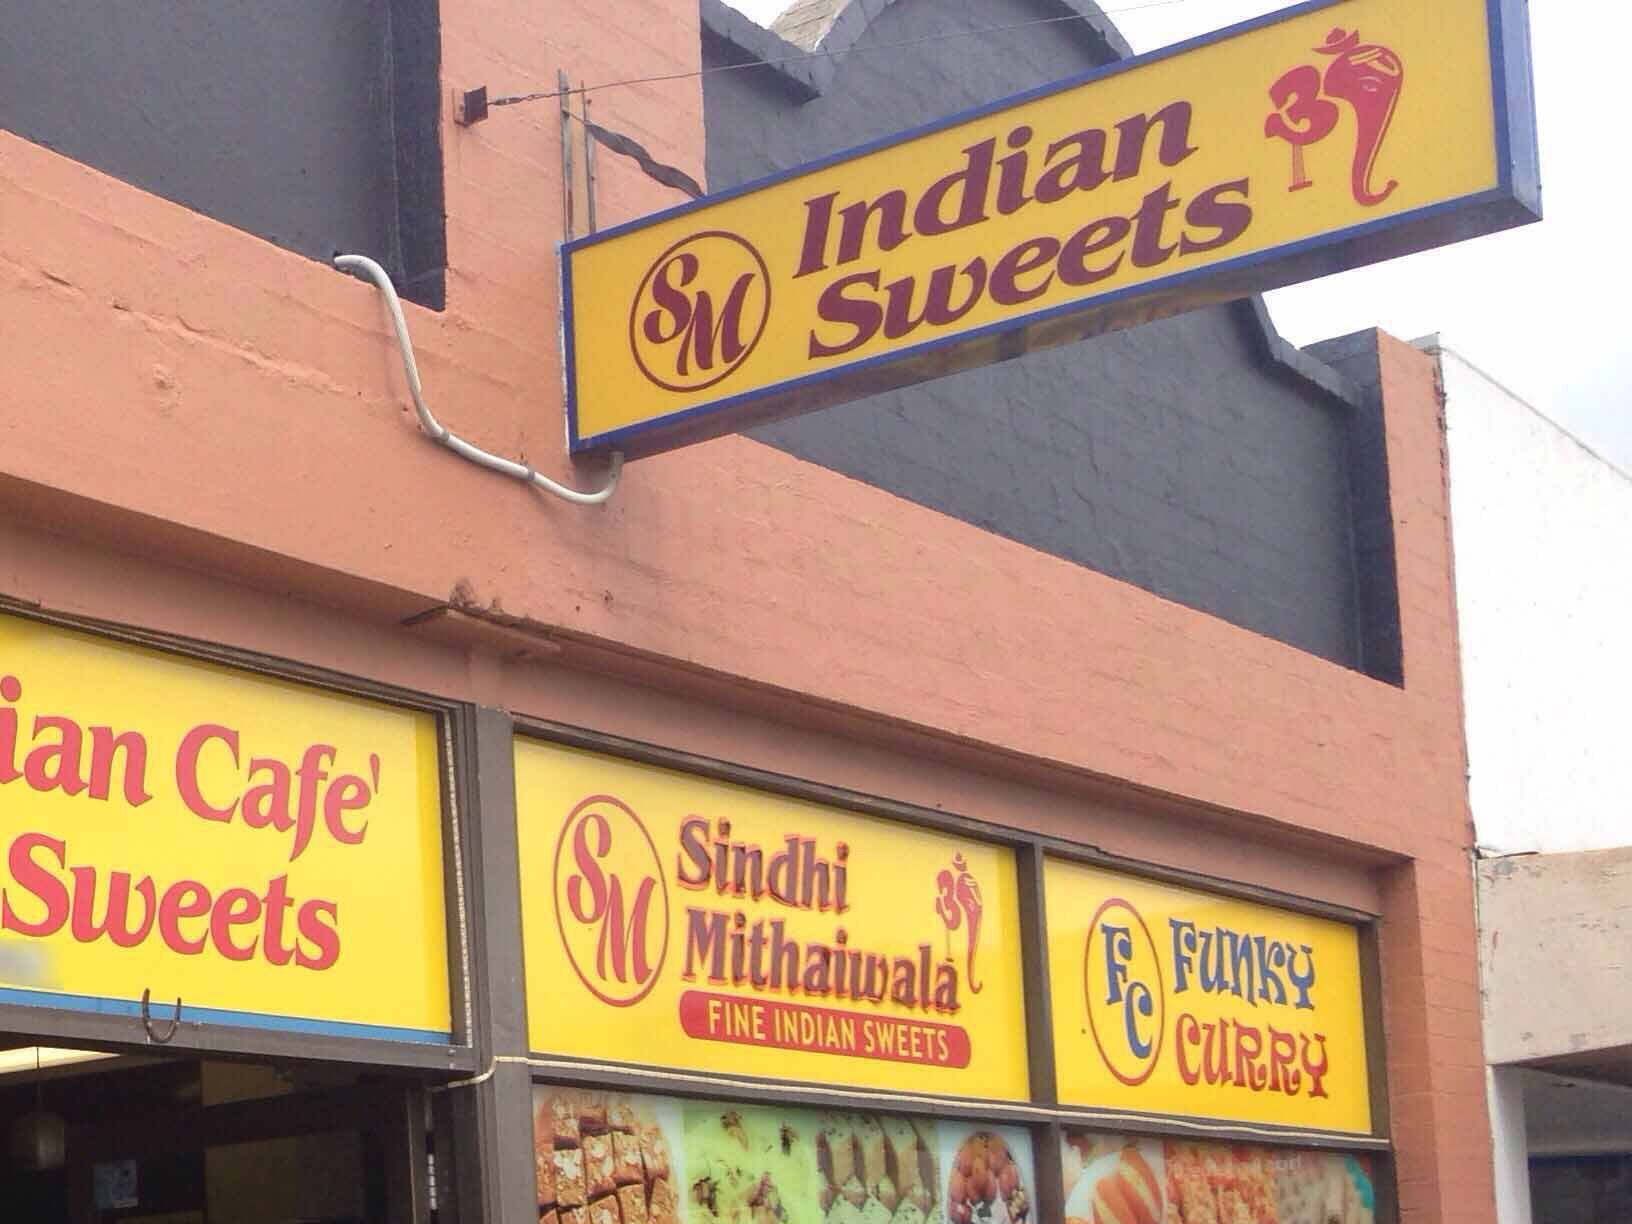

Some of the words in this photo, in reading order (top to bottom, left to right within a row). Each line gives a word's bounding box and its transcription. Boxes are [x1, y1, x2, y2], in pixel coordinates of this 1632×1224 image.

[792, 98, 1198, 280] Indian
[808, 177, 1254, 359] Sweets
[1, 832, 341, 971] Sweets
[677, 814, 850, 914] Sindhi
[682, 906, 962, 1014] Mithaiwala
[1168, 917, 1316, 1010] FUNKY
[708, 999, 766, 1040] FINE
[775, 1008, 856, 1051] INDIAN
[864, 1020, 950, 1062] SWEETS
[1175, 1012, 1329, 1099] CURRY
